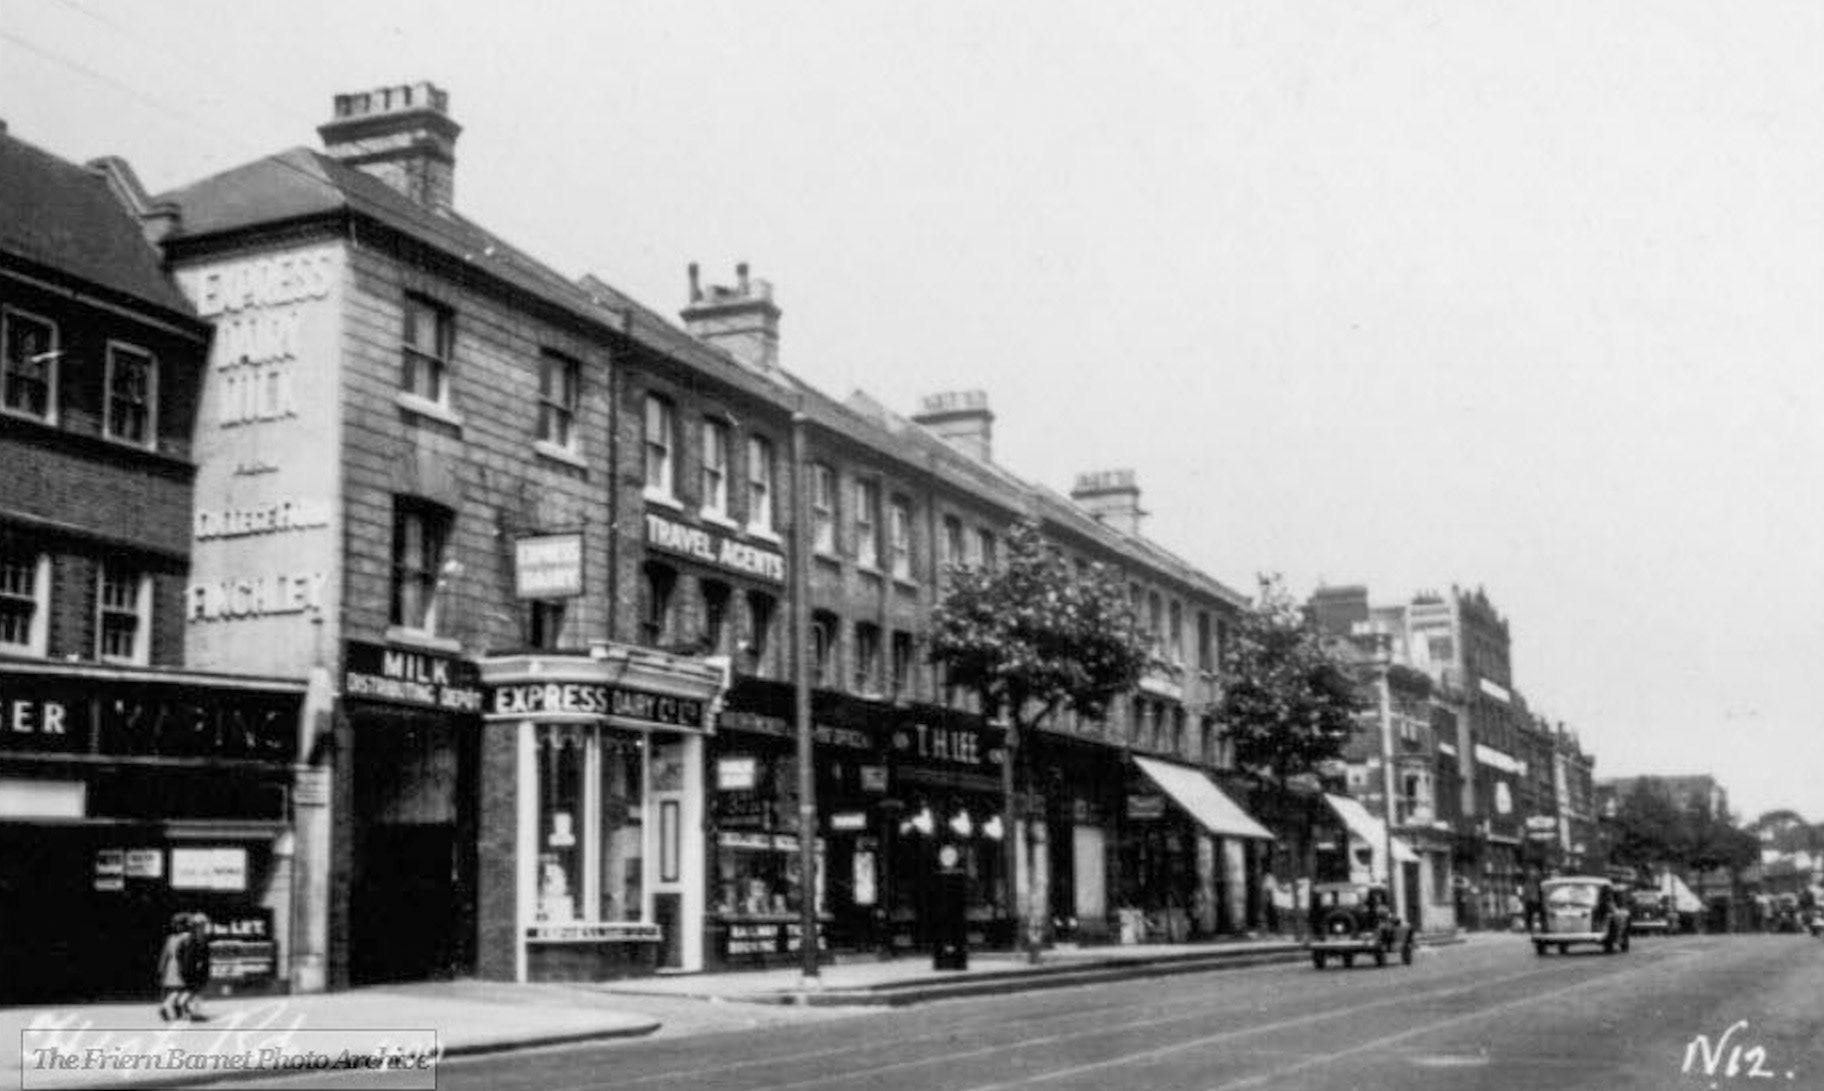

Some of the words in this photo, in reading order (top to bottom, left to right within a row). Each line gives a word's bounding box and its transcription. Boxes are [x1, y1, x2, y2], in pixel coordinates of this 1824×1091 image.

[646, 513, 717, 561] TRAVEL
[720, 538, 784, 580] AGENTS
[383, 650, 449, 685] MILK
[346, 671, 436, 704] DISTRIBUTING
[496, 683, 608, 714] EXPRESS
[612, 690, 654, 718] DAIRY
[0, 700, 66, 734] ER
